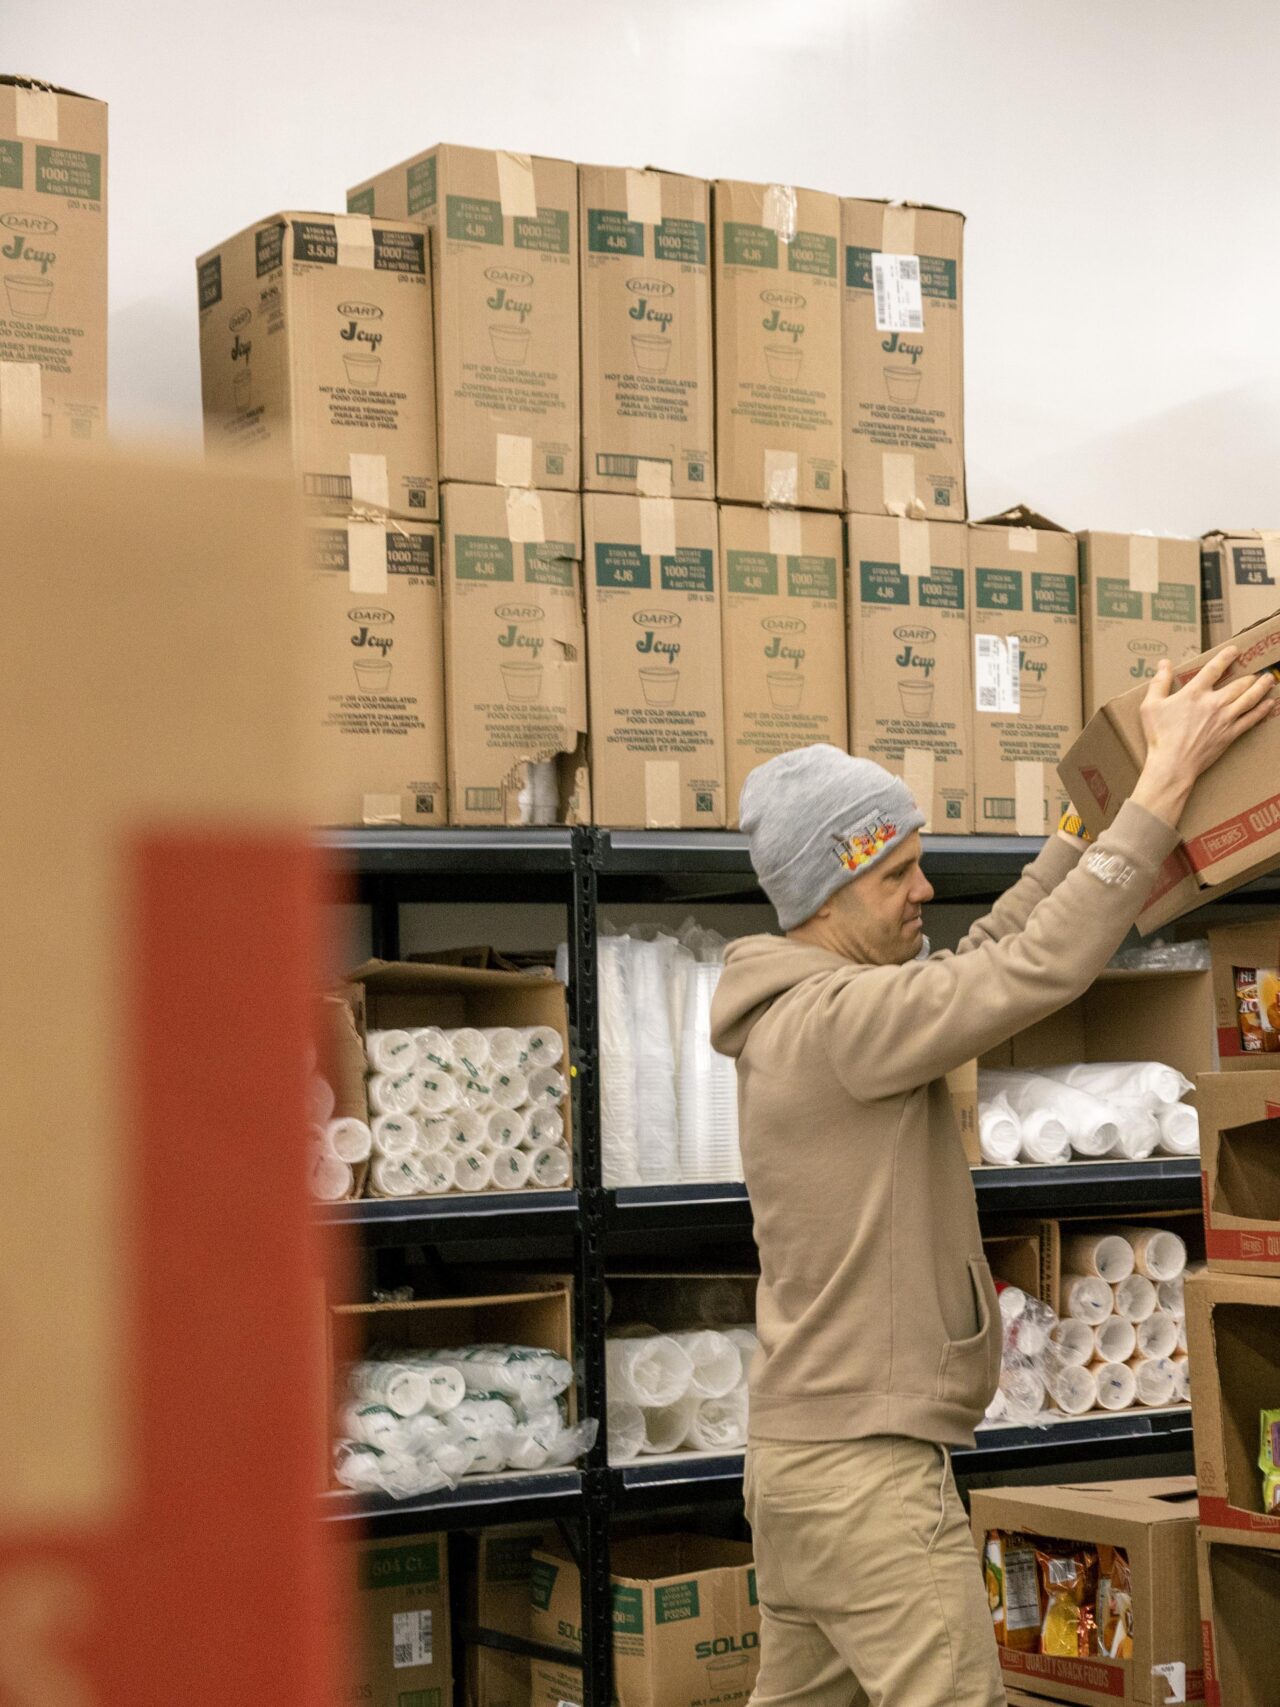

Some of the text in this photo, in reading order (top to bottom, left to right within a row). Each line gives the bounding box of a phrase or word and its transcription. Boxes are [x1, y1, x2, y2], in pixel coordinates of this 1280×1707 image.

[5, 215, 52, 230] DART
[658, 235, 681, 248] 1000
[379, 247, 402, 259] 1000
[634, 281, 669, 294] DART
[342, 304, 377, 316] DART
[613, 569, 633, 581] 4J6
[664, 566, 688, 577] 1000
[922, 584, 942, 595] 1000
[991, 593, 1009, 604] 4J6
[354, 611, 388, 621] DART
[639, 614, 675, 624] DART
[900, 630, 931, 639] DART
[614, 708, 632, 716] HOT
[666, 710, 706, 718] INSULATED
[1208, 828, 1242, 852] HERR'S
[696, 1632, 759, 1659] SOLO
